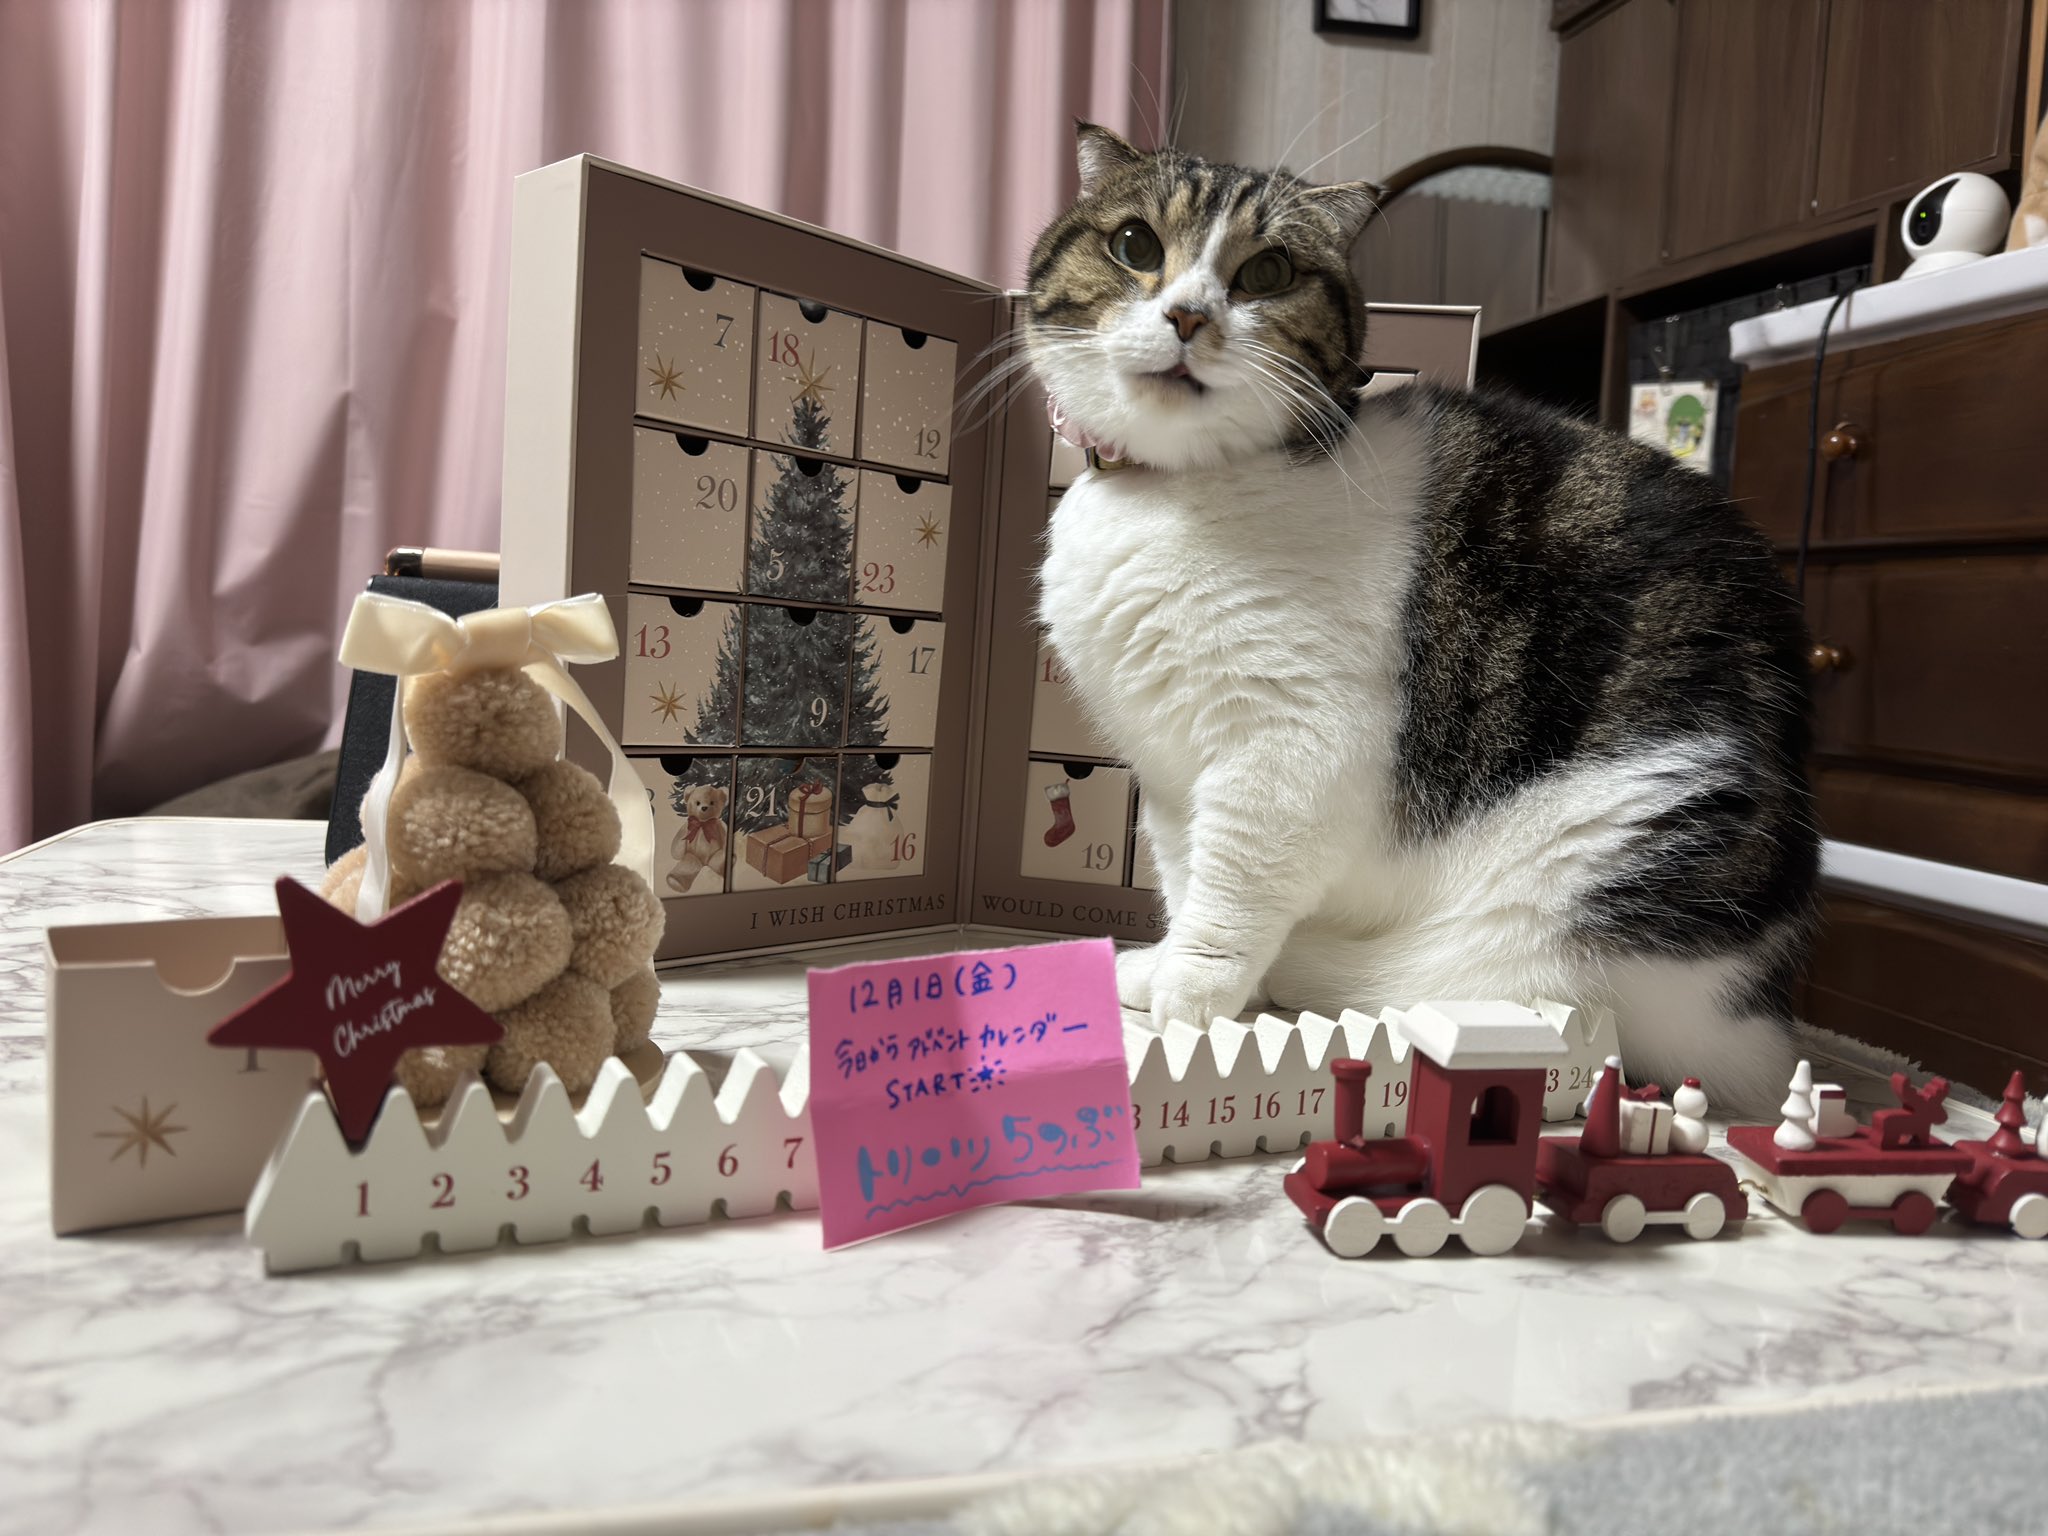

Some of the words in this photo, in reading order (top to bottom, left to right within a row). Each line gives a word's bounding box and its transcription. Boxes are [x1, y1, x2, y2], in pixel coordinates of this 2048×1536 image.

[714, 313, 735, 349] 7
[767, 330, 800, 367] 18
[914, 427, 941, 460] 12
[695, 475, 738, 512] 20
[766, 548, 785, 581] 5
[862, 562, 896, 594] 23
[634, 624, 671, 659] 13
[908, 646, 936, 675] 17
[810, 697, 828, 727] 9
[745, 786, 778, 818] 21
[890, 832, 917, 863] 16
[1080, 843, 1114, 872] 19
[750, 912, 758, 930] I
[768, 905, 825, 928] WISH
[834, 893, 946, 921] CHRISTMAS
[983, 894, 1064, 919] WOULD
[1072, 905, 1138, 928] COME
[325, 960, 401, 1011] Merry
[333, 986, 438, 1058] Christmas
[886, 1072, 965, 1110] START
[355, 1180, 371, 1217] 1
[430, 1172, 456, 1209] 2
[506, 1164, 530, 1201] 3
[579, 1158, 604, 1193] 4
[650, 1150, 672, 1186] 5
[717, 1143, 739, 1178] 6
[783, 1136, 804, 1170] 7
[1159, 1099, 1190, 1129] 14
[1207, 1094, 1236, 1125] 15
[1252, 1090, 1281, 1120] 16
[1296, 1088, 1326, 1116] 17
[1382, 1080, 1408, 1108] 19
[1568, 1065, 1594, 1091] 24
